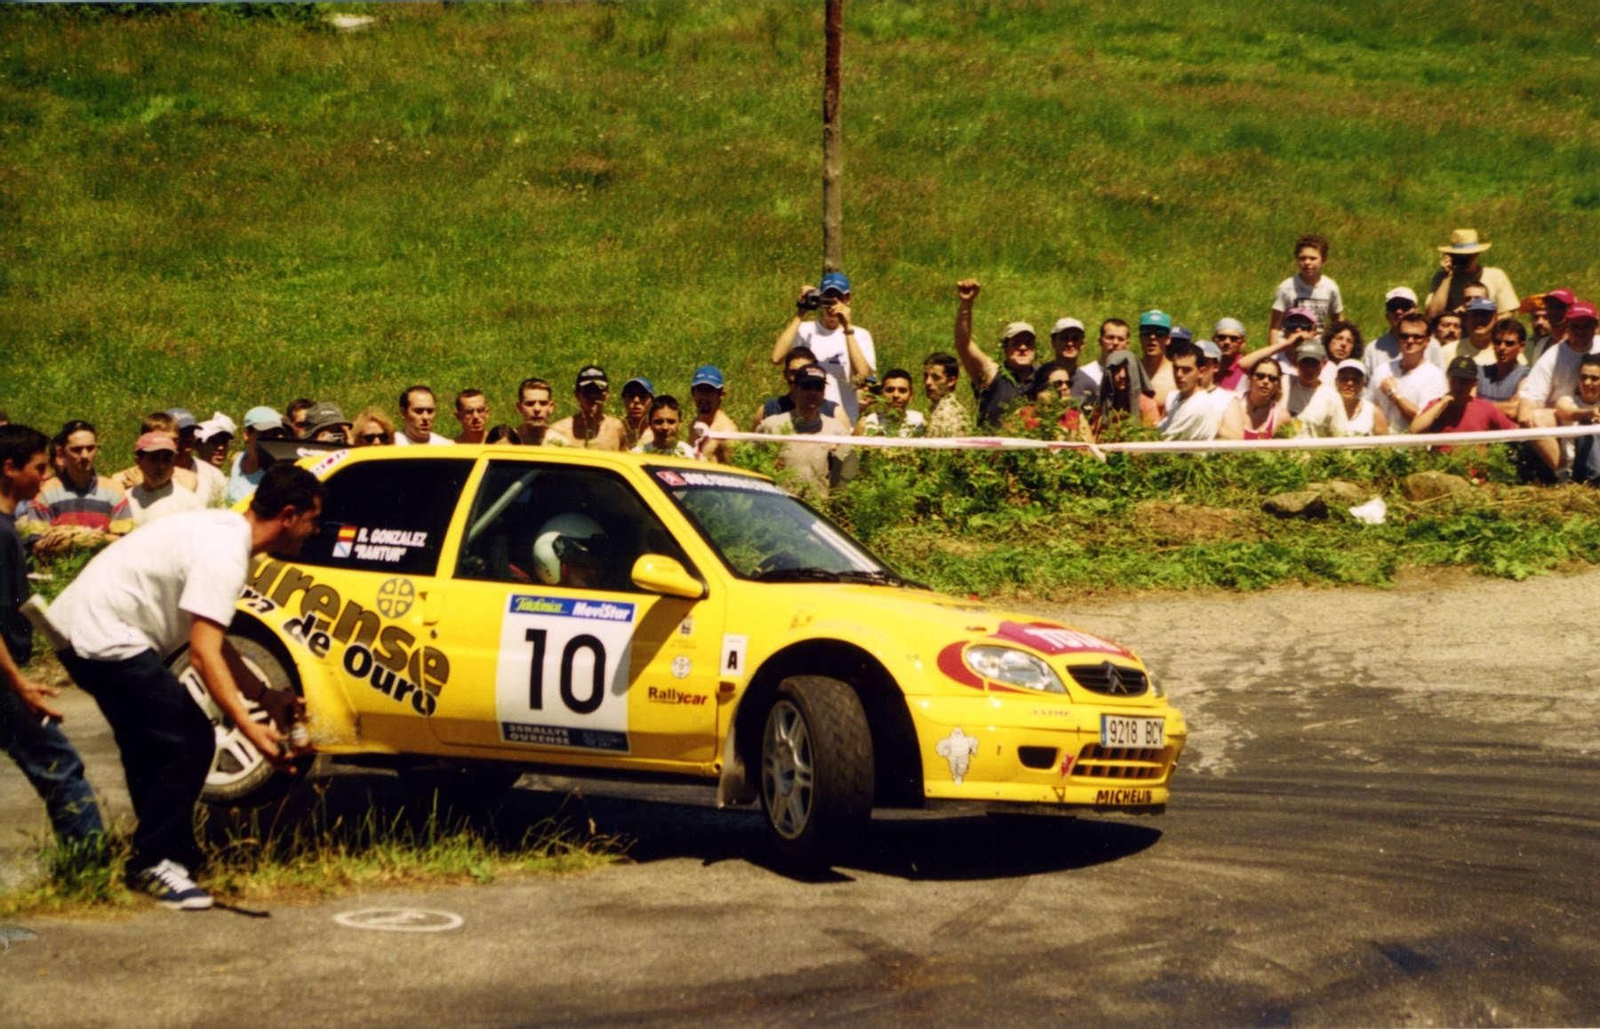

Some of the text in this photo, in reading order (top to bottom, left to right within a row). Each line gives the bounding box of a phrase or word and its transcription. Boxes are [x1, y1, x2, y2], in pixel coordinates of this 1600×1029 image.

[370, 528, 428, 547] GONZALEZ
[247, 562, 450, 697] urense
[727, 650, 738, 670] A
[344, 645, 437, 718] Ouro
[525, 628, 607, 715] 10
[648, 686, 708, 705] Rallycar
[1110, 719, 1164, 744] 9218 BCY
[1095, 790, 1152, 804] MICHELIN
